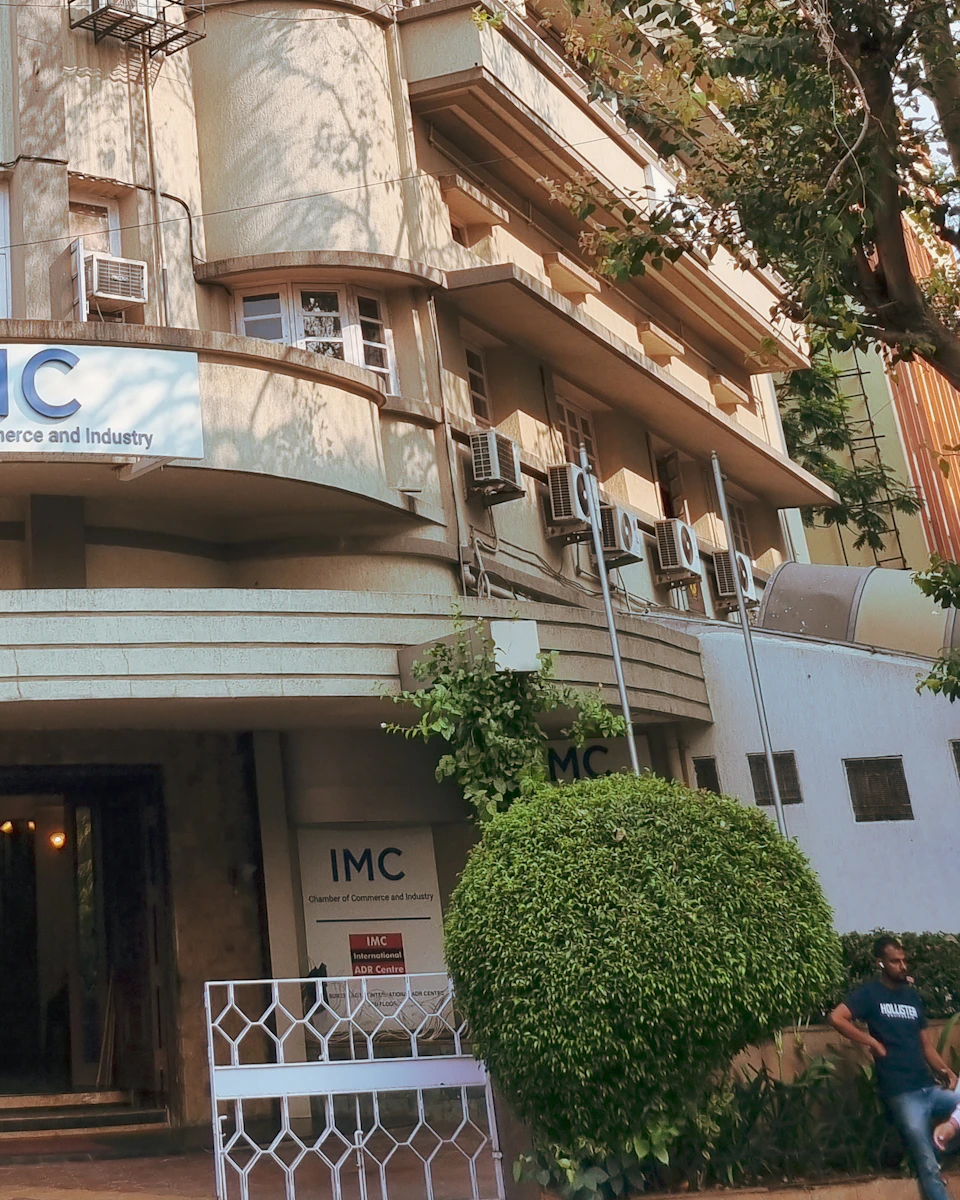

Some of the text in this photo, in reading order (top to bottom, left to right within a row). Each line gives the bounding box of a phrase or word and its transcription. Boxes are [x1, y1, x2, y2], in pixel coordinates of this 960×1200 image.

[48, 427, 81, 443] and
[86, 427, 154, 450] Industry
[547, 744, 612, 781] MC
[330, 847, 406, 882] IMC
[308, 892, 434, 903] Chamber of Commerce and Industry
[366, 935, 388, 947] IMC
[353, 951, 403, 960] International
[354, 965, 405, 975] ADR Centre
[880, 1002, 918, 1018] HOLLISTER
